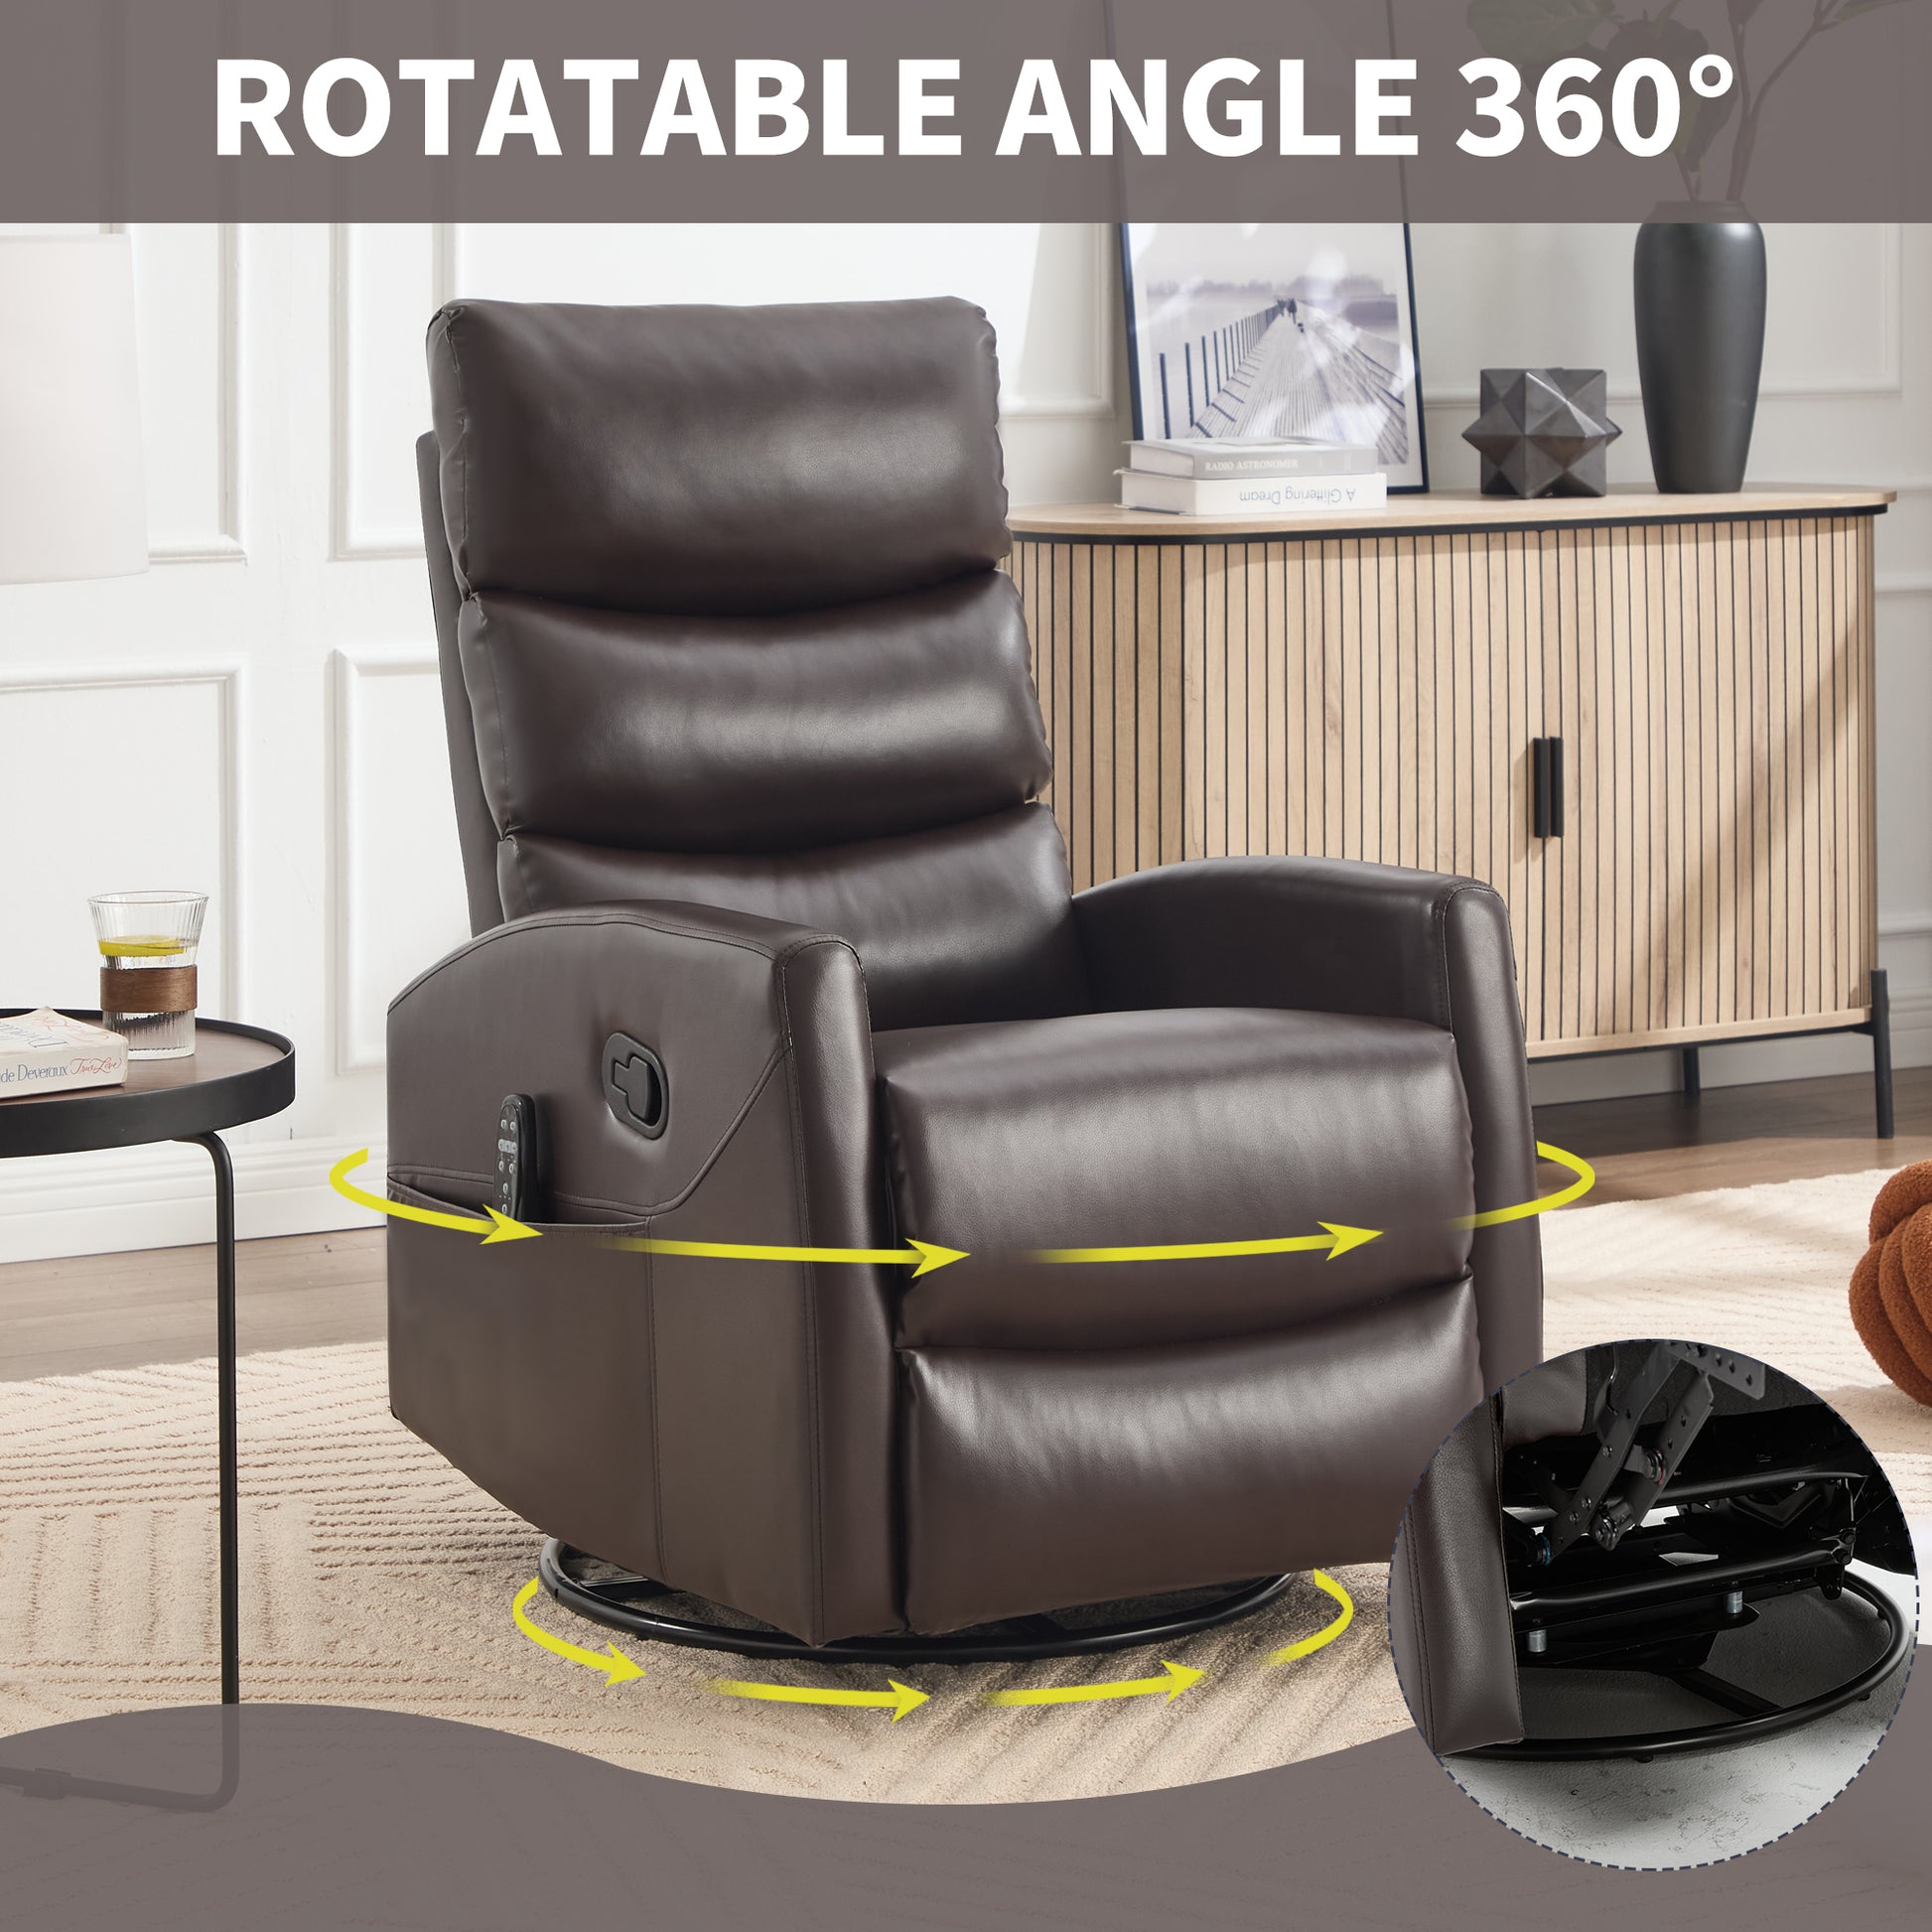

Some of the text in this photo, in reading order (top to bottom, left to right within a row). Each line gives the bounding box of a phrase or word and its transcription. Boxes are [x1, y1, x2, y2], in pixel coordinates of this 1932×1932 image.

[1204, 462, 1234, 472] RADIO
[1239, 485, 1356, 505] A Glittering Dream
[17, 1063, 68, 1081] Deveraux
